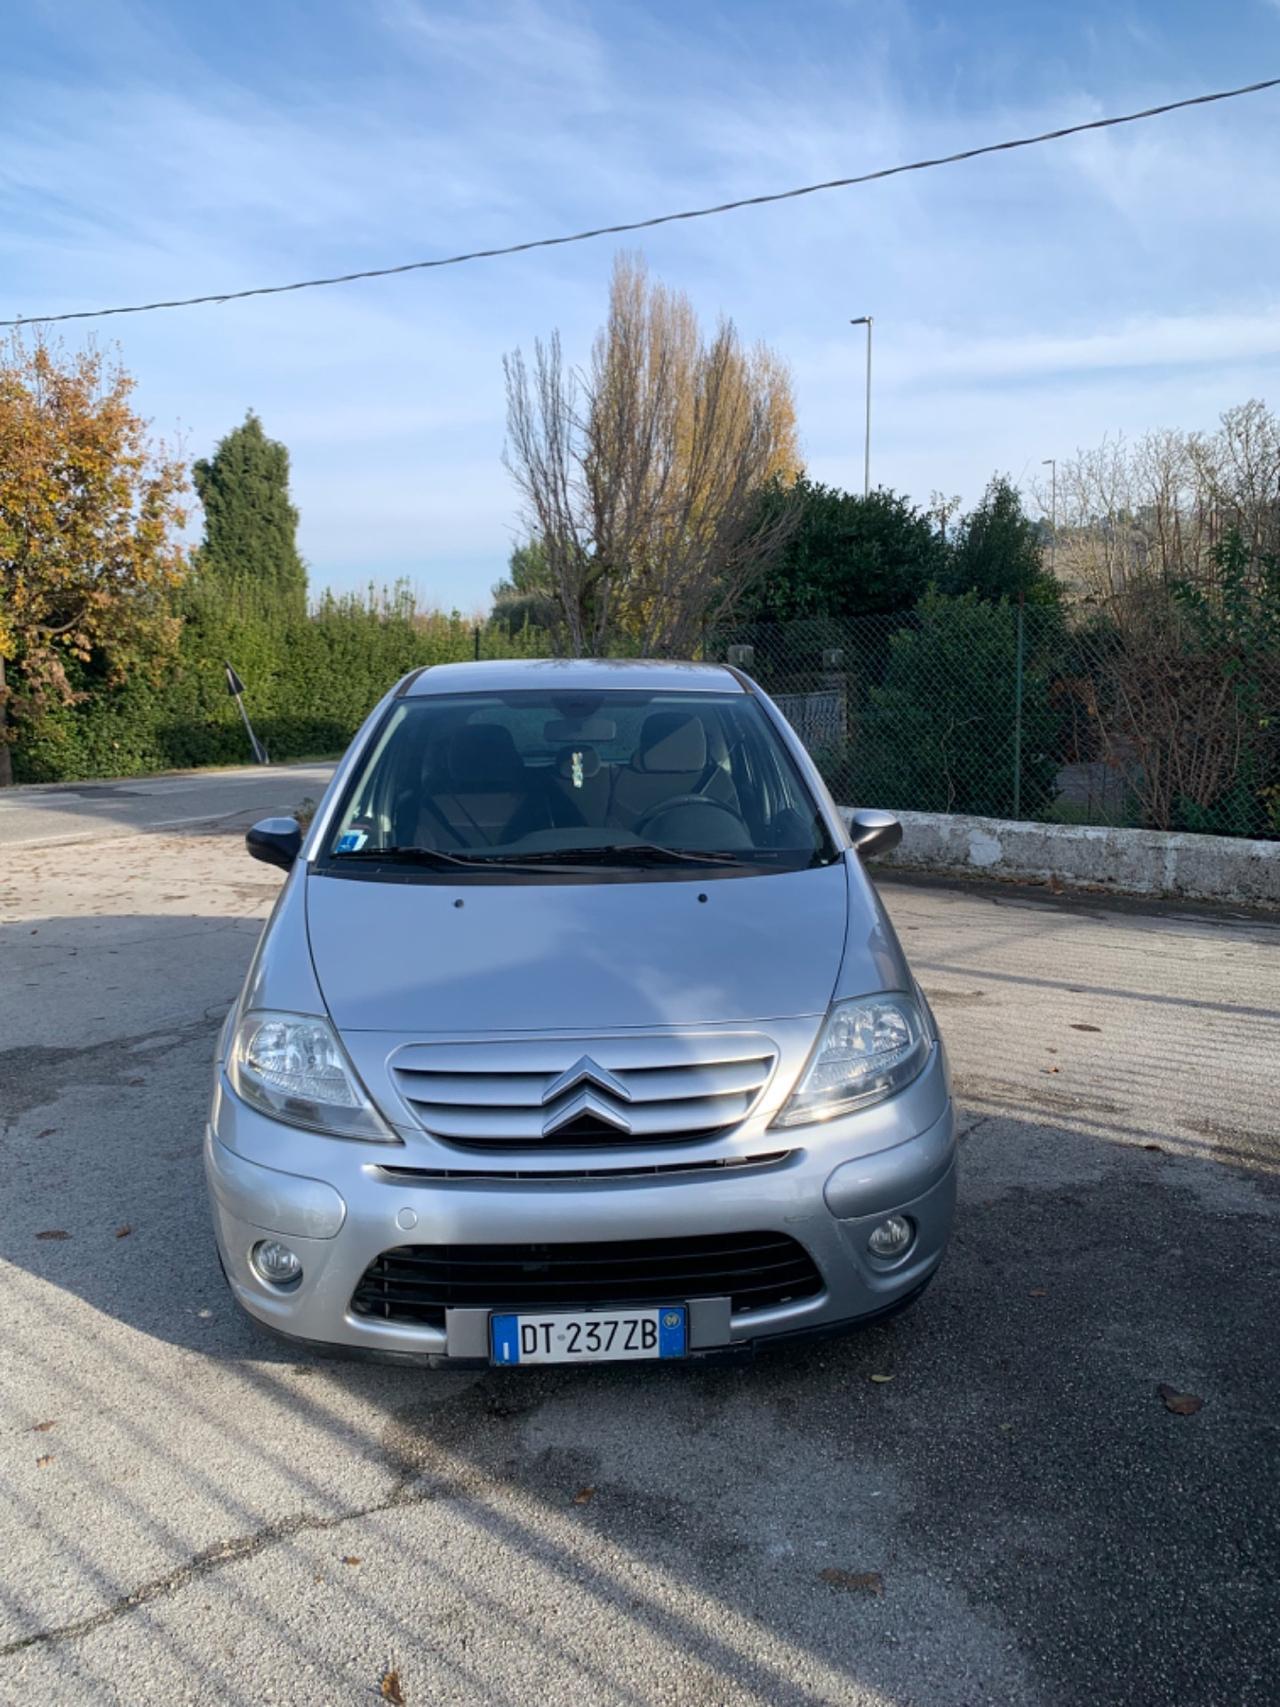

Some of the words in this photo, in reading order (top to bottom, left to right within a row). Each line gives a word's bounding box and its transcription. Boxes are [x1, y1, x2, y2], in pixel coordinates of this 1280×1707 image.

[521, 1323, 554, 1354] DT
[566, 1319, 657, 1352] 237ZB
[503, 1342, 509, 1360] I
